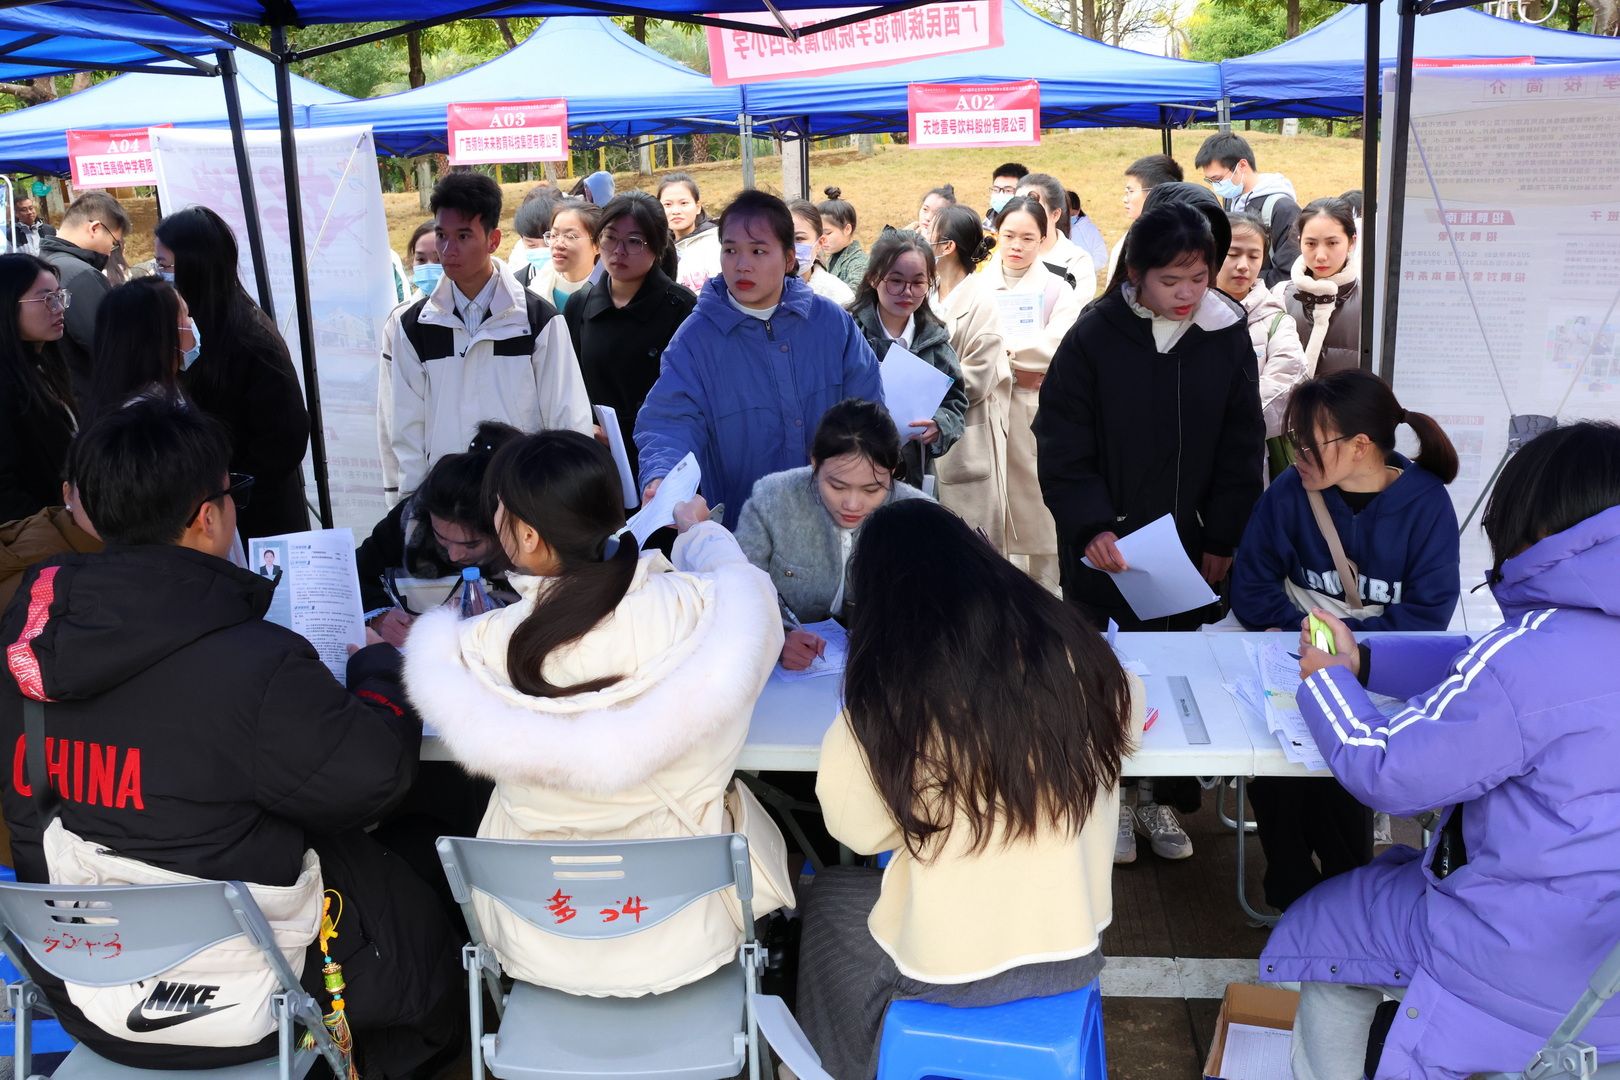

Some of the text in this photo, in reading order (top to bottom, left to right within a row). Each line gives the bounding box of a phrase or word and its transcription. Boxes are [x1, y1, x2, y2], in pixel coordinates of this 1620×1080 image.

[955, 94, 995, 110] A02
[489, 112, 526, 128] A03
[923, 116, 1027, 135] 天地壹号饮料股份有限公司
[106, 139, 141, 154] A04
[143, 980, 221, 1012] NIKE
